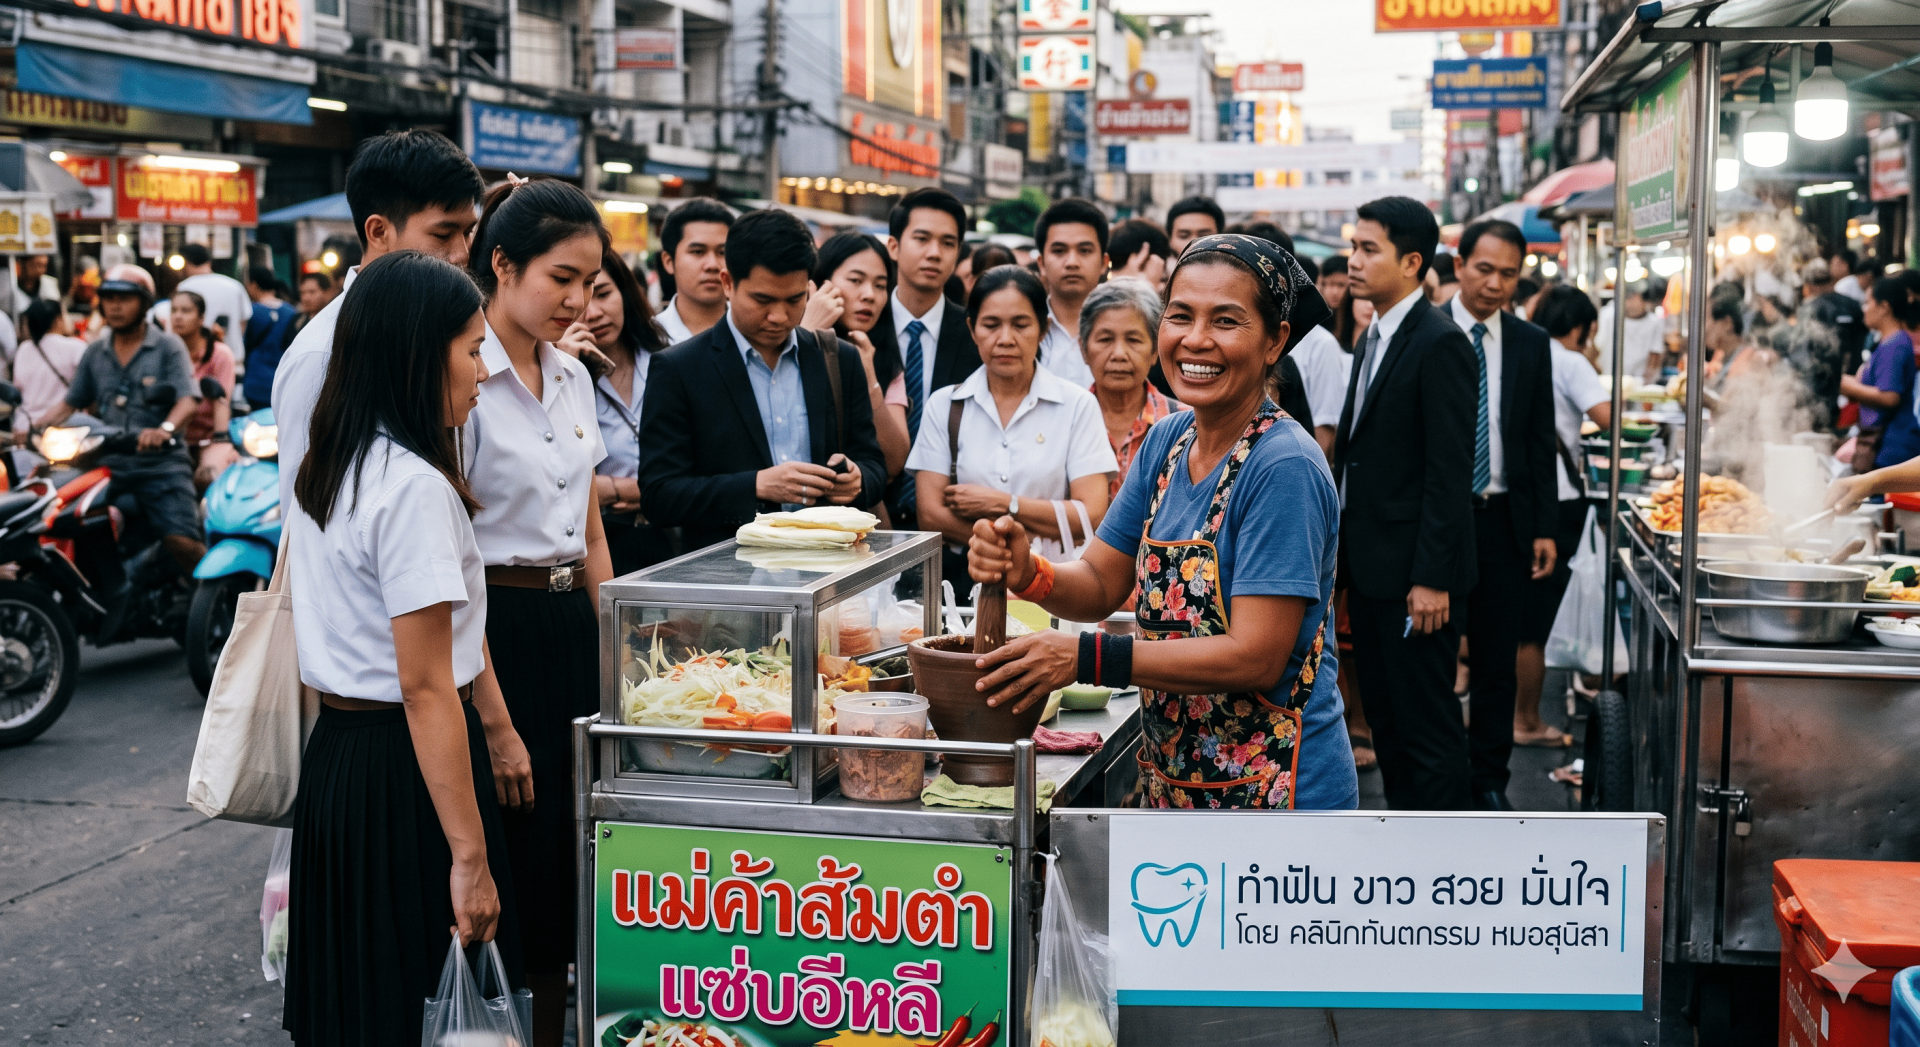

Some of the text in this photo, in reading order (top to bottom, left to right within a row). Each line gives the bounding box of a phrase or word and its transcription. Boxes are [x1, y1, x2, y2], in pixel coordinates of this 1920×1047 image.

[611, 848, 995, 951] แม่ค้าส้มตำ
[1237, 854, 1609, 906] ทำฟัน ขาว สวย มั่นใจ
[1235, 912, 1609, 955] โดย คลินิกทันตกรรม หมอสุนิสา
[660, 945, 943, 1037] แซ่บอีหลี
